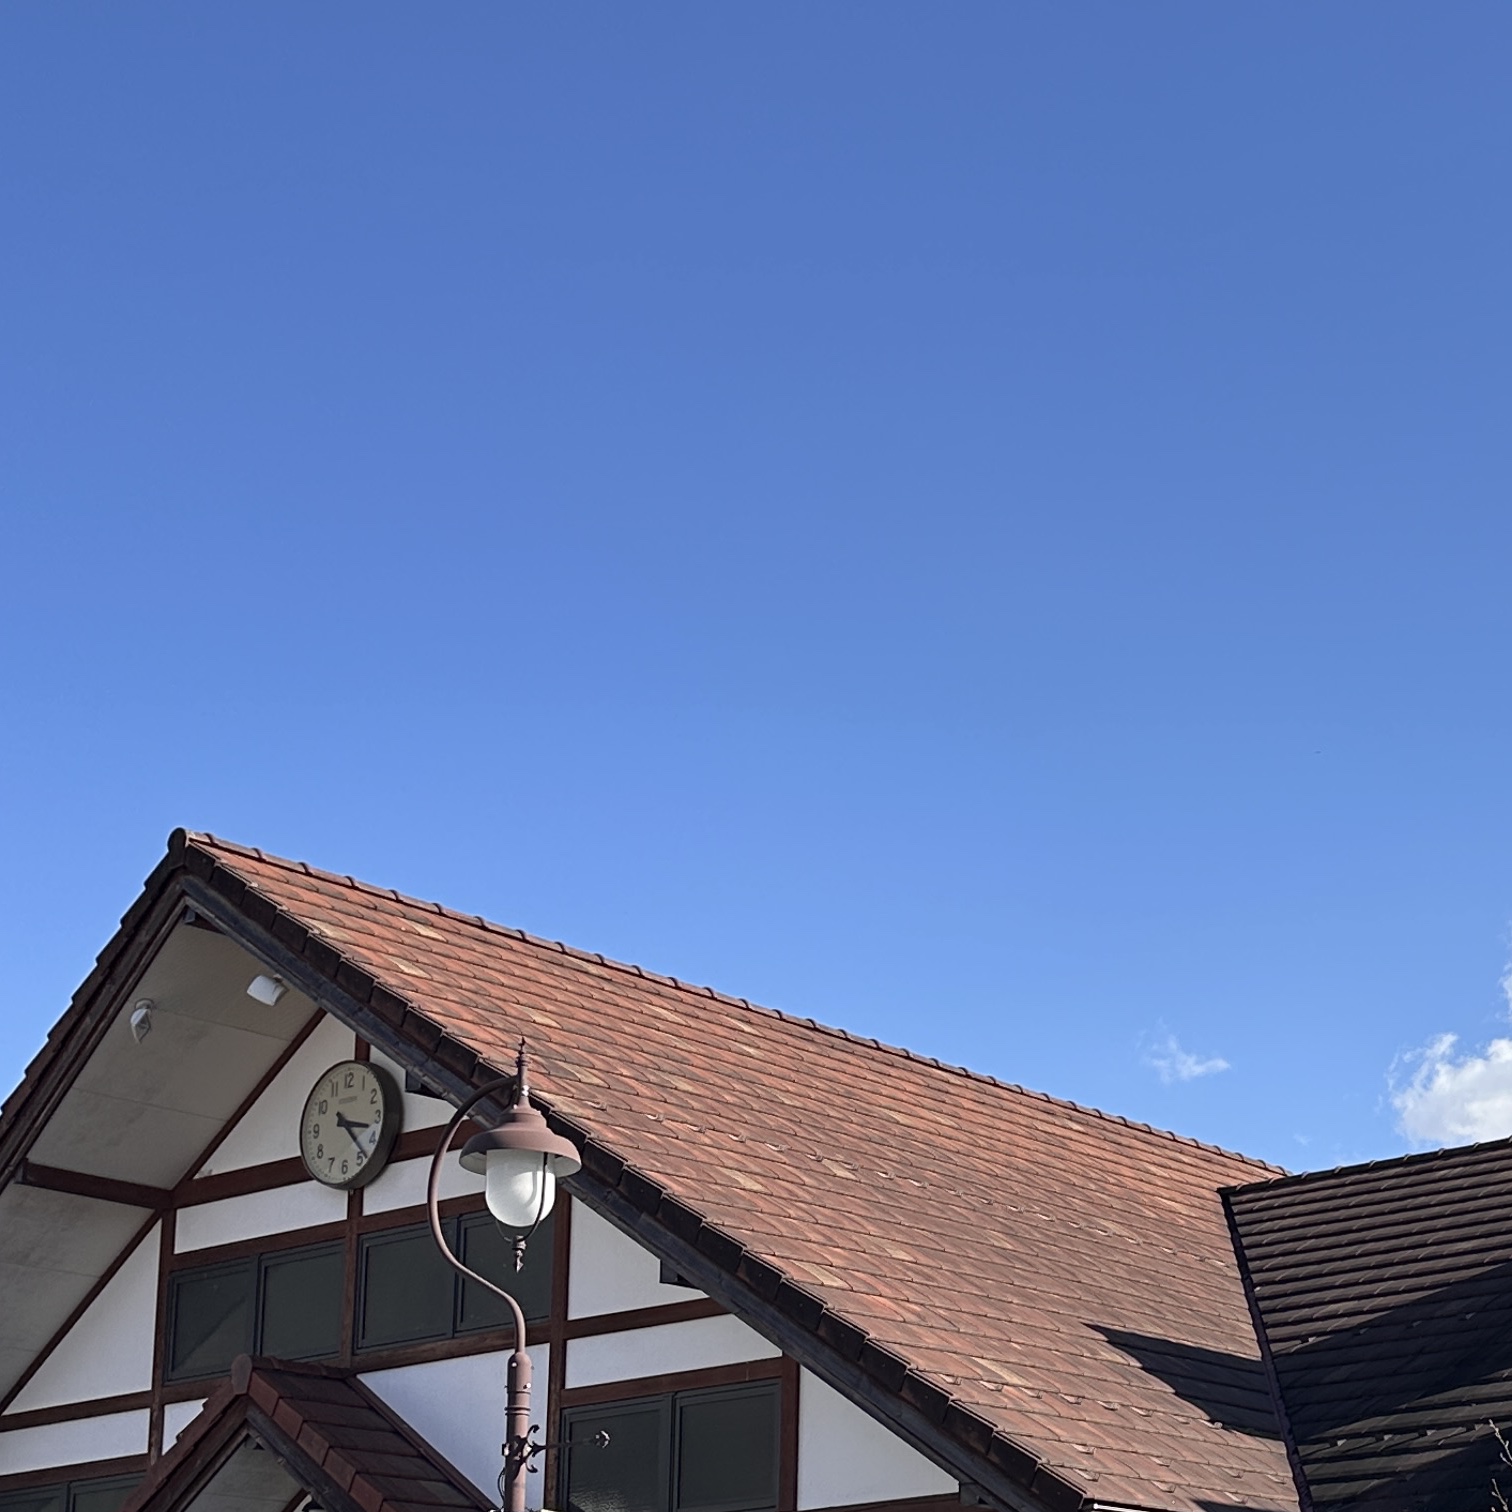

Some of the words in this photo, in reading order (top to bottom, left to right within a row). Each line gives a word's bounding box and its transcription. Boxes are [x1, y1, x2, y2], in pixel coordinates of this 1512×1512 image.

[344, 1072, 354, 1088] 12
[362, 1075, 365, 1091] 1
[328, 1080, 338, 1098] 11
[370, 1088, 377, 1104] 2
[319, 1100, 328, 1115] 10
[375, 1110, 381, 1124] 3
[313, 1124, 319, 1139] 9
[369, 1131, 376, 1144] 4
[317, 1144, 323, 1159] 8
[356, 1151, 364, 1166] 5
[328, 1158, 335, 1173] 7
[341, 1160, 348, 1175] 6
